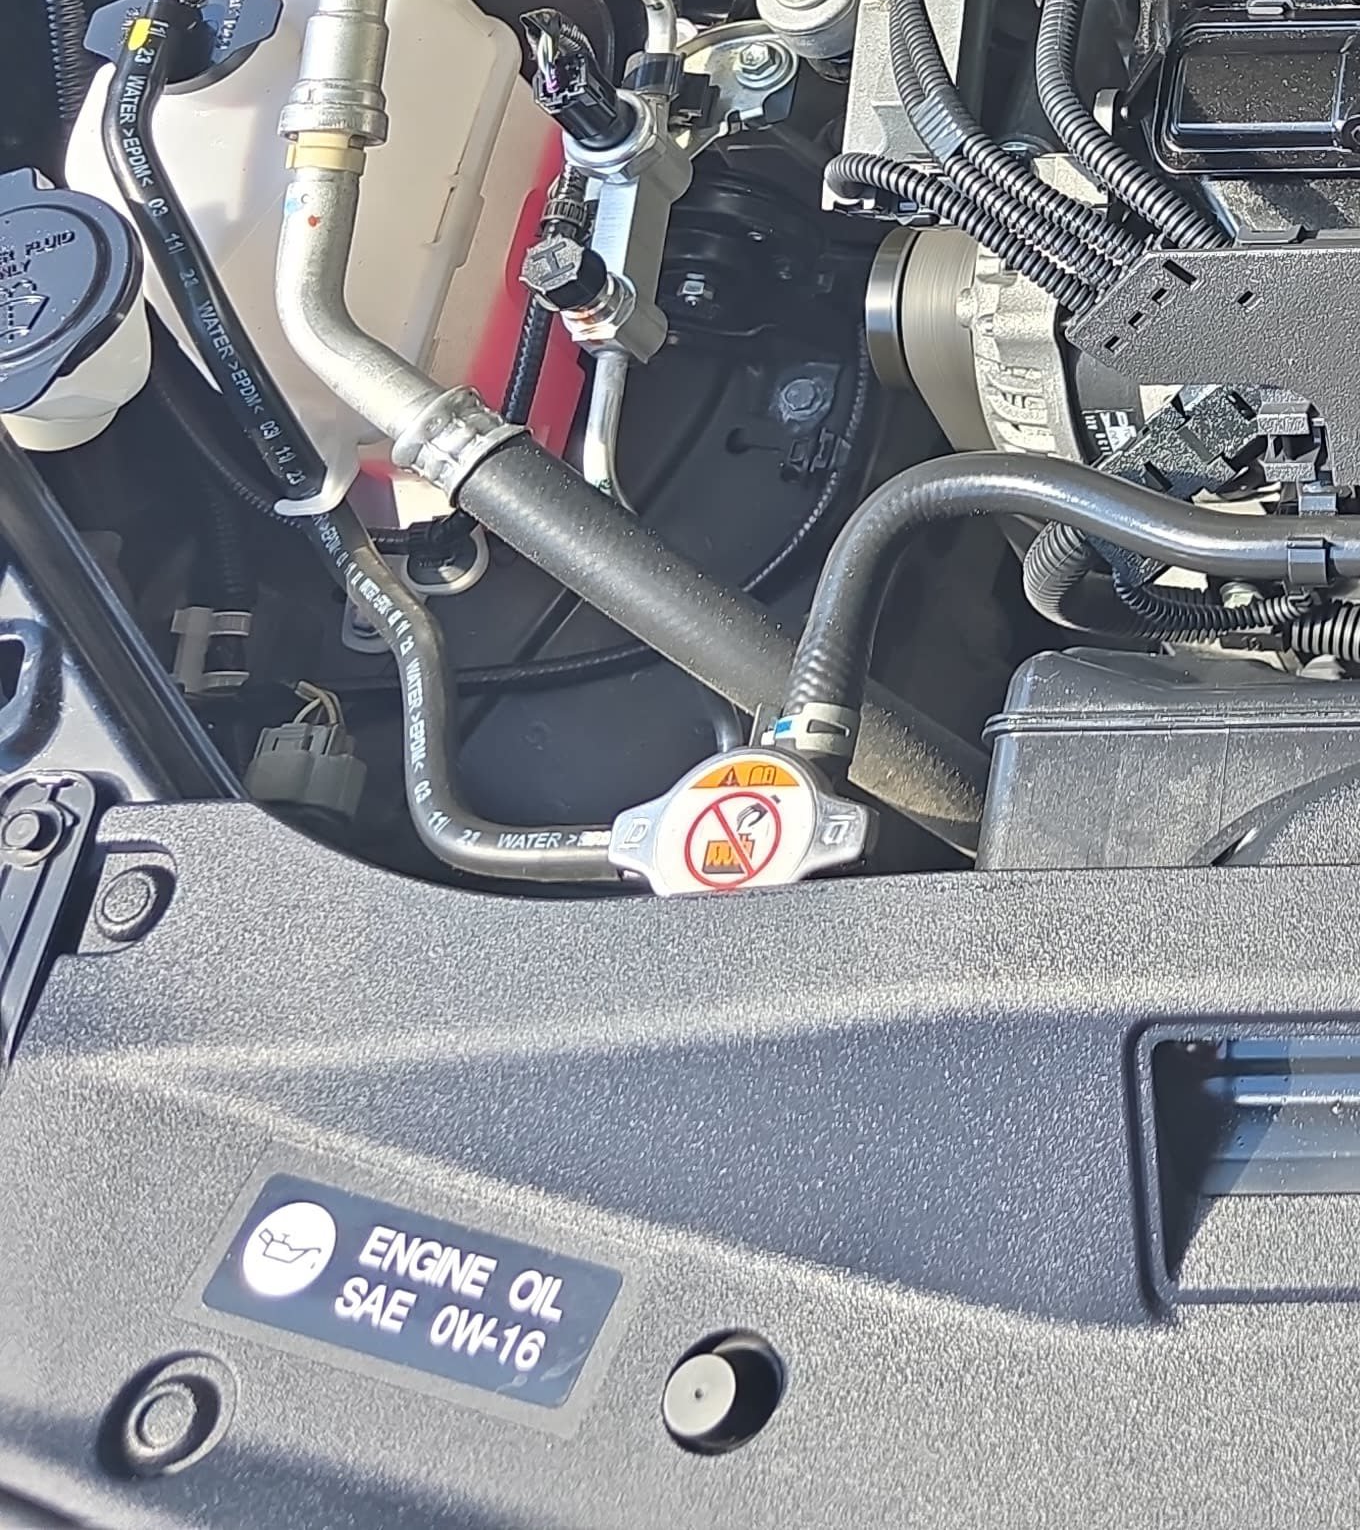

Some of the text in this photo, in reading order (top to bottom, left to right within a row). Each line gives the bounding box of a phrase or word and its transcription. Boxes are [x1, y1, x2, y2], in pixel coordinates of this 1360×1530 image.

[134, 46, 156, 64] 23
[119, 74, 148, 125] WATER
[121, 128, 155, 186] >EPDM<
[148, 197, 169, 217] 03
[25, 231, 76, 255] FLUID
[197, 300, 235, 360] WATER
[228, 360, 265, 414] >EPDM<
[404, 657, 425, 710] WATER
[408, 712, 427, 771] >EPDM<
[414, 779, 433, 803] 03
[497, 831, 562, 849] WATER
[358, 1225, 564, 1322] ENGINE OIL
[334, 1284, 545, 1372] SAE 0W-16
